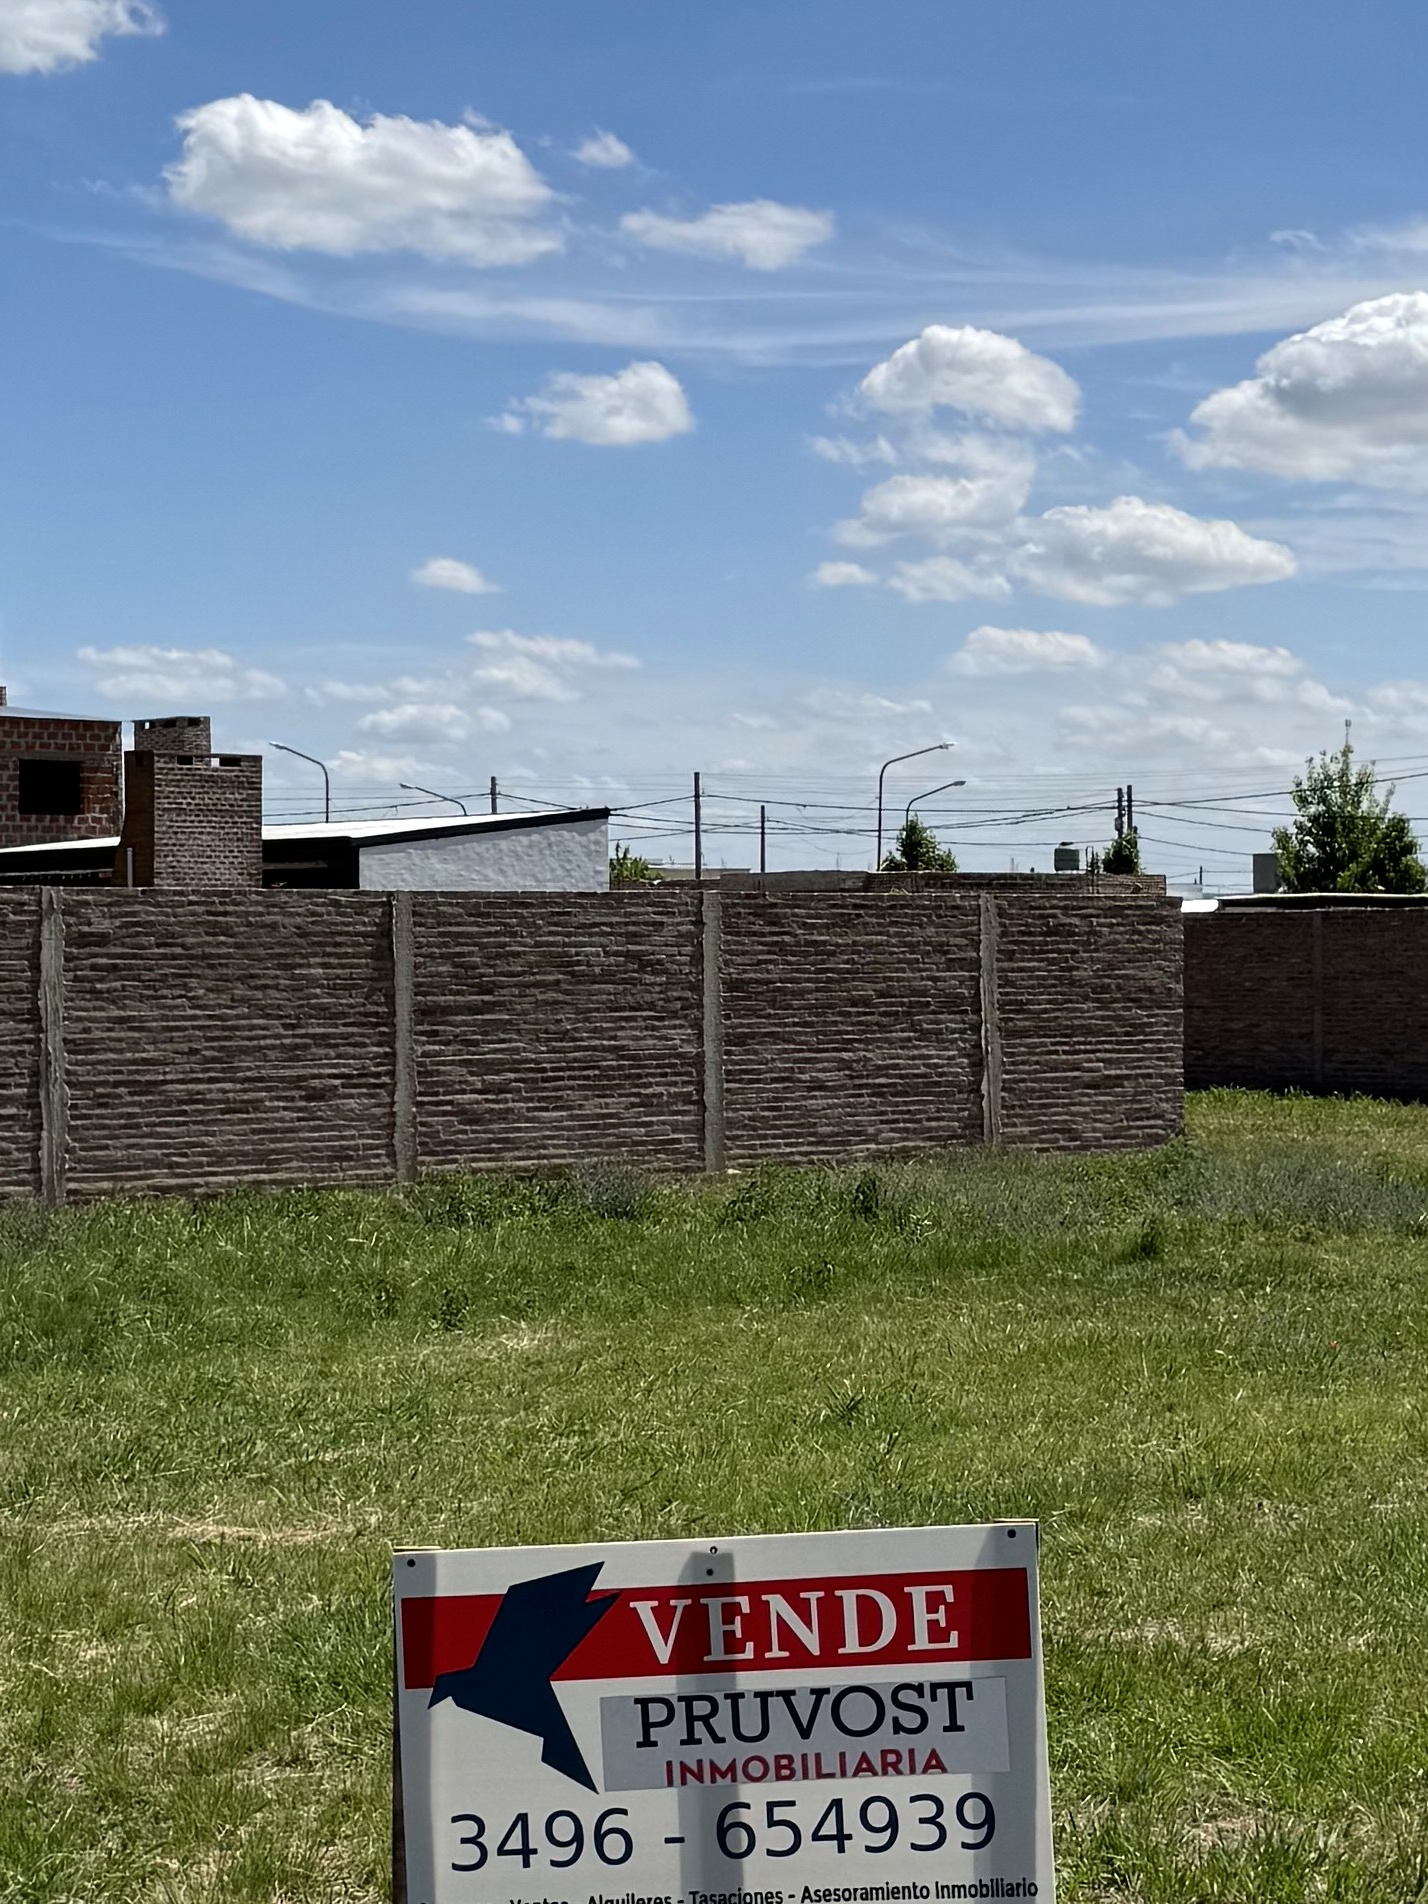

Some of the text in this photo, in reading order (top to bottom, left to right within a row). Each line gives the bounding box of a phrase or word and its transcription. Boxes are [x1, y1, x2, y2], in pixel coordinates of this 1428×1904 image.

[629, 1584, 959, 1665] VENDE
[633, 1681, 974, 1749] PRUVOST
[665, 1747, 948, 1788] INMOBILIARIA
[449, 1806, 634, 1873] 3496
[715, 1791, 996, 1860] 654939
[800, 1881, 930, 1904] Asesoramiento
[935, 1877, 1038, 1900] Inmobiliario
